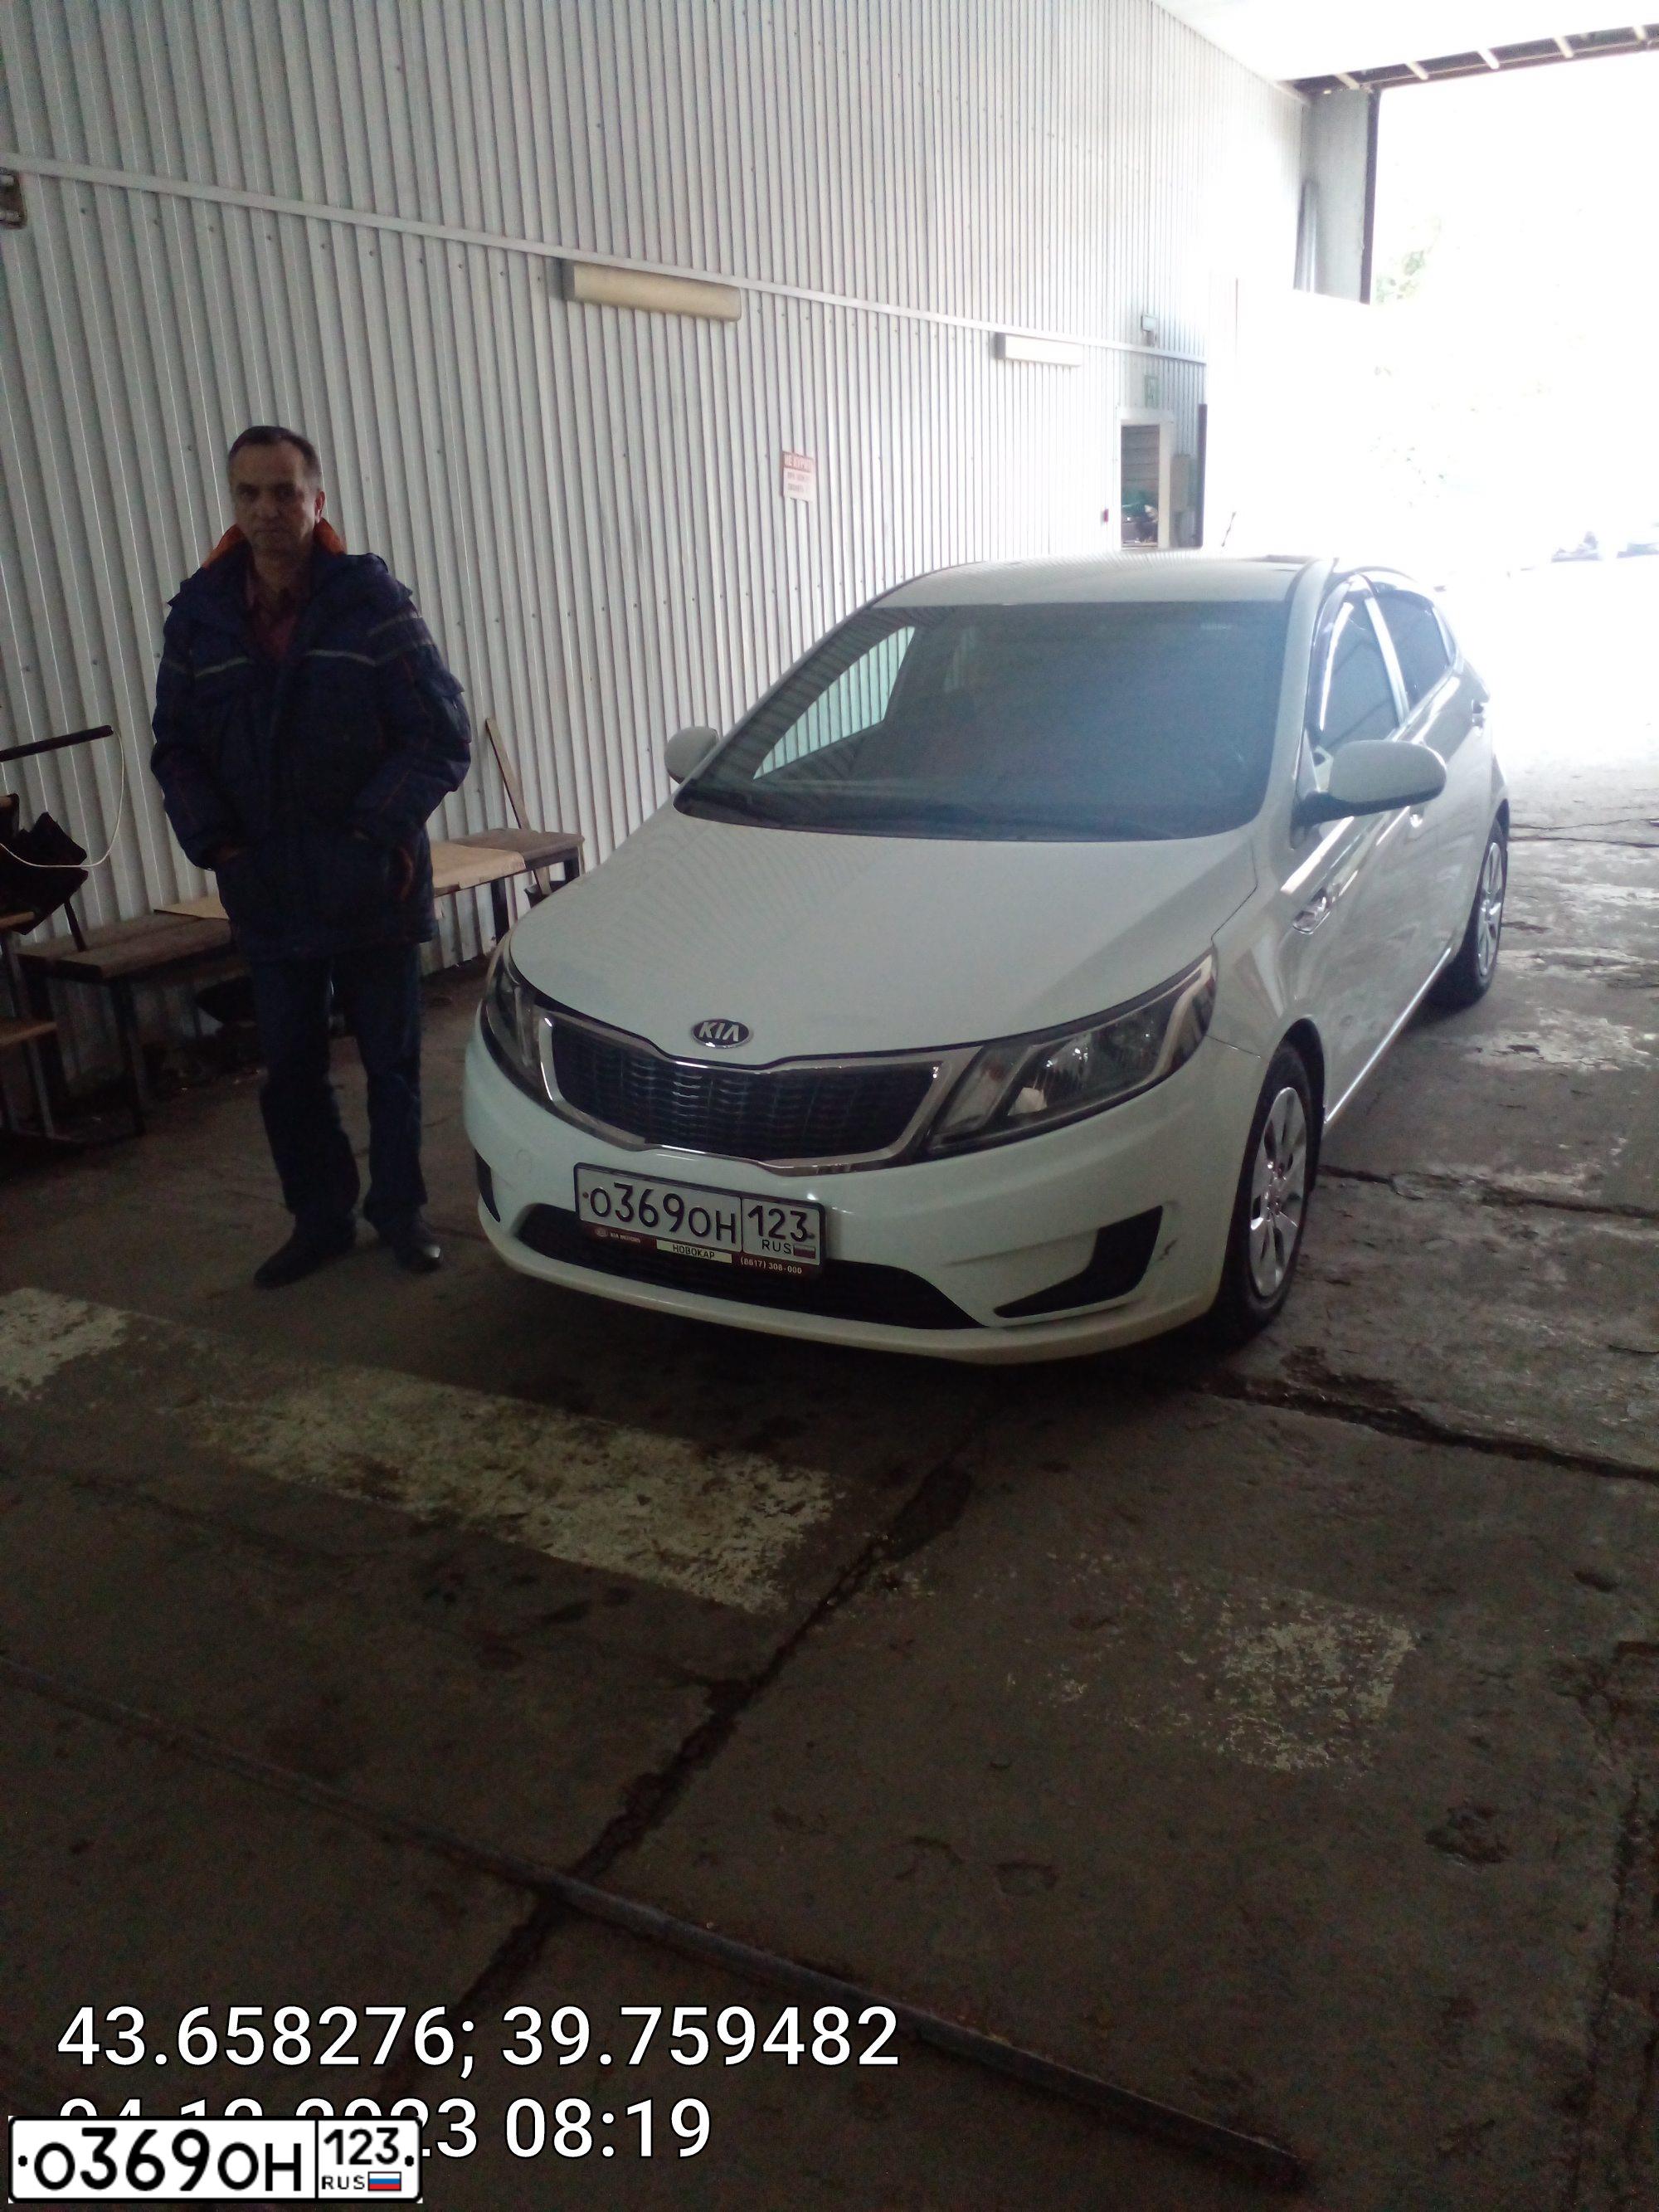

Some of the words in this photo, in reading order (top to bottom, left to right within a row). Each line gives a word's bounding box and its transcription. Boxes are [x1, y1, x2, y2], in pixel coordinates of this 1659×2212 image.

[698, 1021, 739, 1042] KIA
[590, 1182, 737, 1244] О369ОН
[747, 1206, 807, 1243] 123
[672, 1244, 715, 1260] НОВОКАР
[761, 1239, 792, 1255] RUS
[740, 1256, 766, 1269] (8617)
[768, 1262, 802, 1274] 308-000
